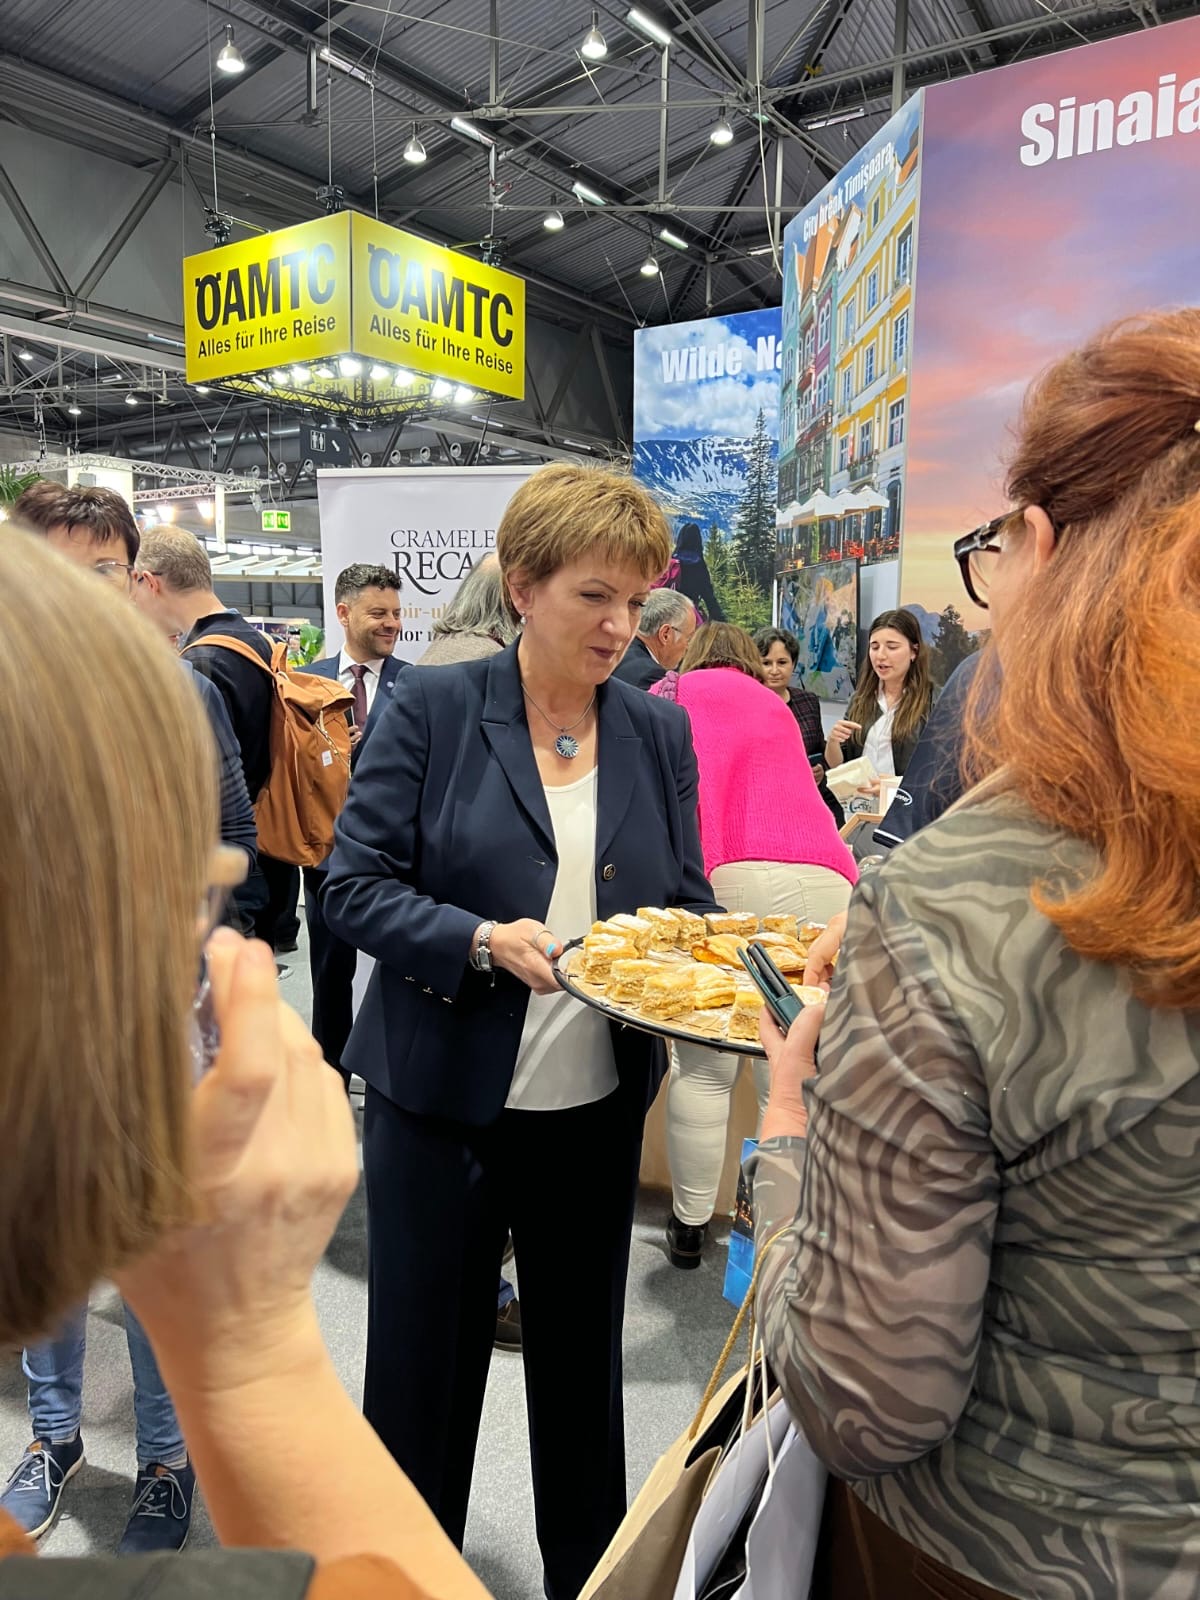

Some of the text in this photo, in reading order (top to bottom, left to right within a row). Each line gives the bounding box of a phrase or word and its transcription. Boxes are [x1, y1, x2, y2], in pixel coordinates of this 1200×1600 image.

[1020, 73, 1200, 167] Sinaia
[803, 212, 819, 243] City
[820, 187, 844, 229] break
[195, 242, 336, 331] ÖAMTC
[367, 242, 513, 347] ÖAMTC
[198, 315, 336, 359] Alles für Ihre Reise
[369, 314, 513, 375] Alles für Ihre Reise
[661, 343, 742, 384] Wilde
[390, 529, 496, 548] CRAMELE
[391, 551, 495, 595] RECA
